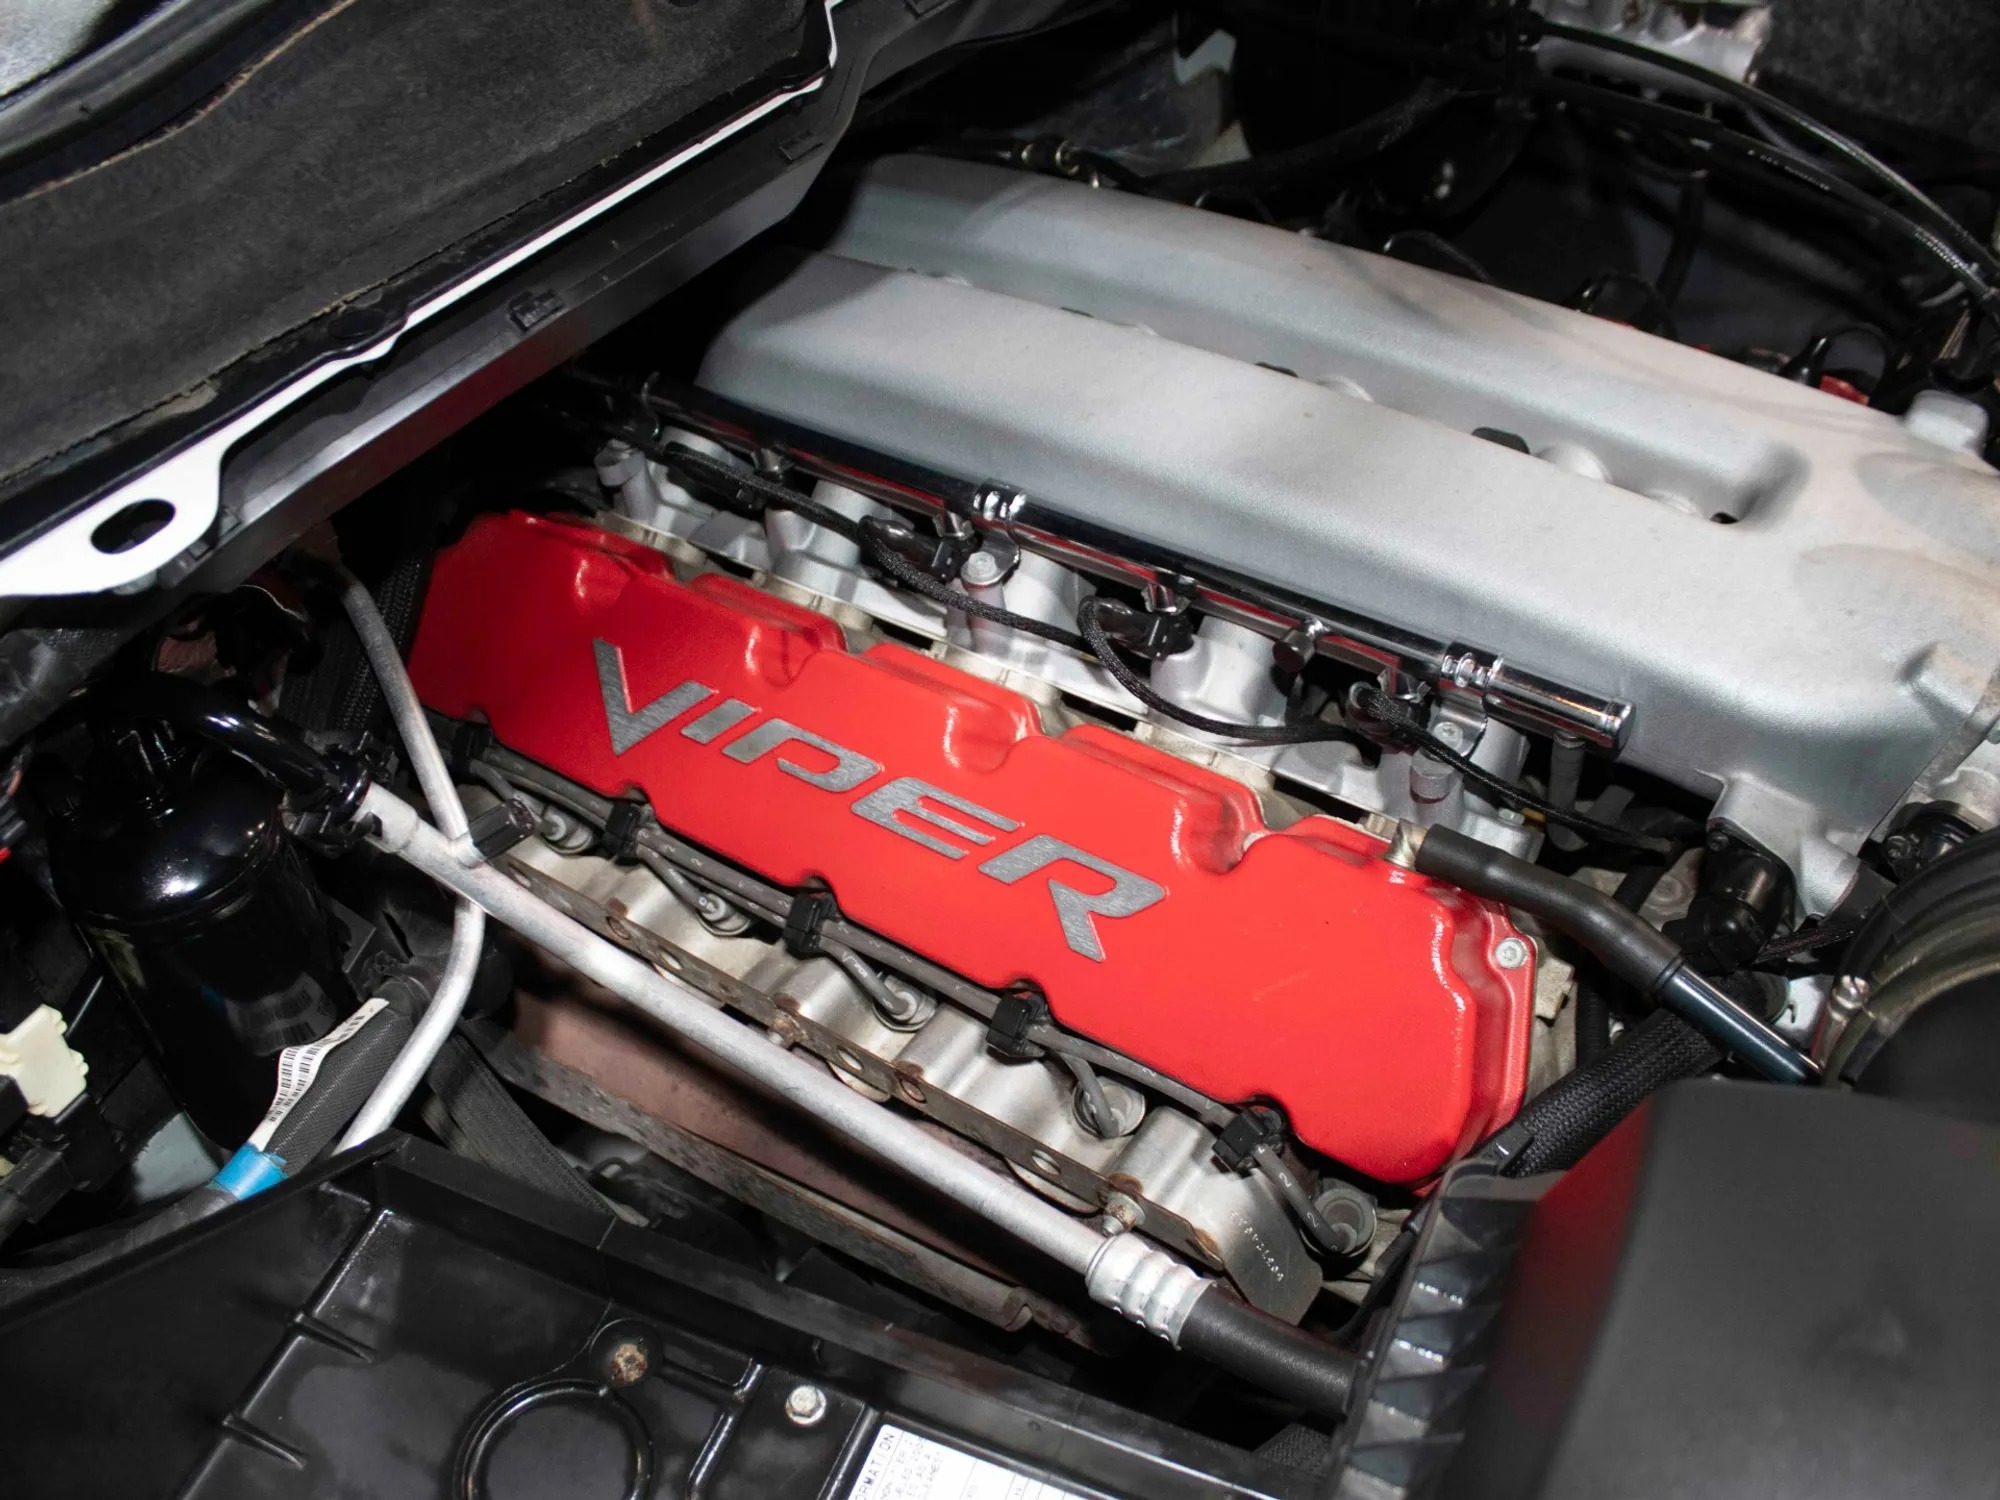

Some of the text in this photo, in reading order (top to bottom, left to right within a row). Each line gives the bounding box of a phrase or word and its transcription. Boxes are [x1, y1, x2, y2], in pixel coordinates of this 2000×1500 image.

[593, 638, 1167, 962] VIPER
[1279, 1171, 1293, 1188] 2
[1306, 1211, 1320, 1228] 2
